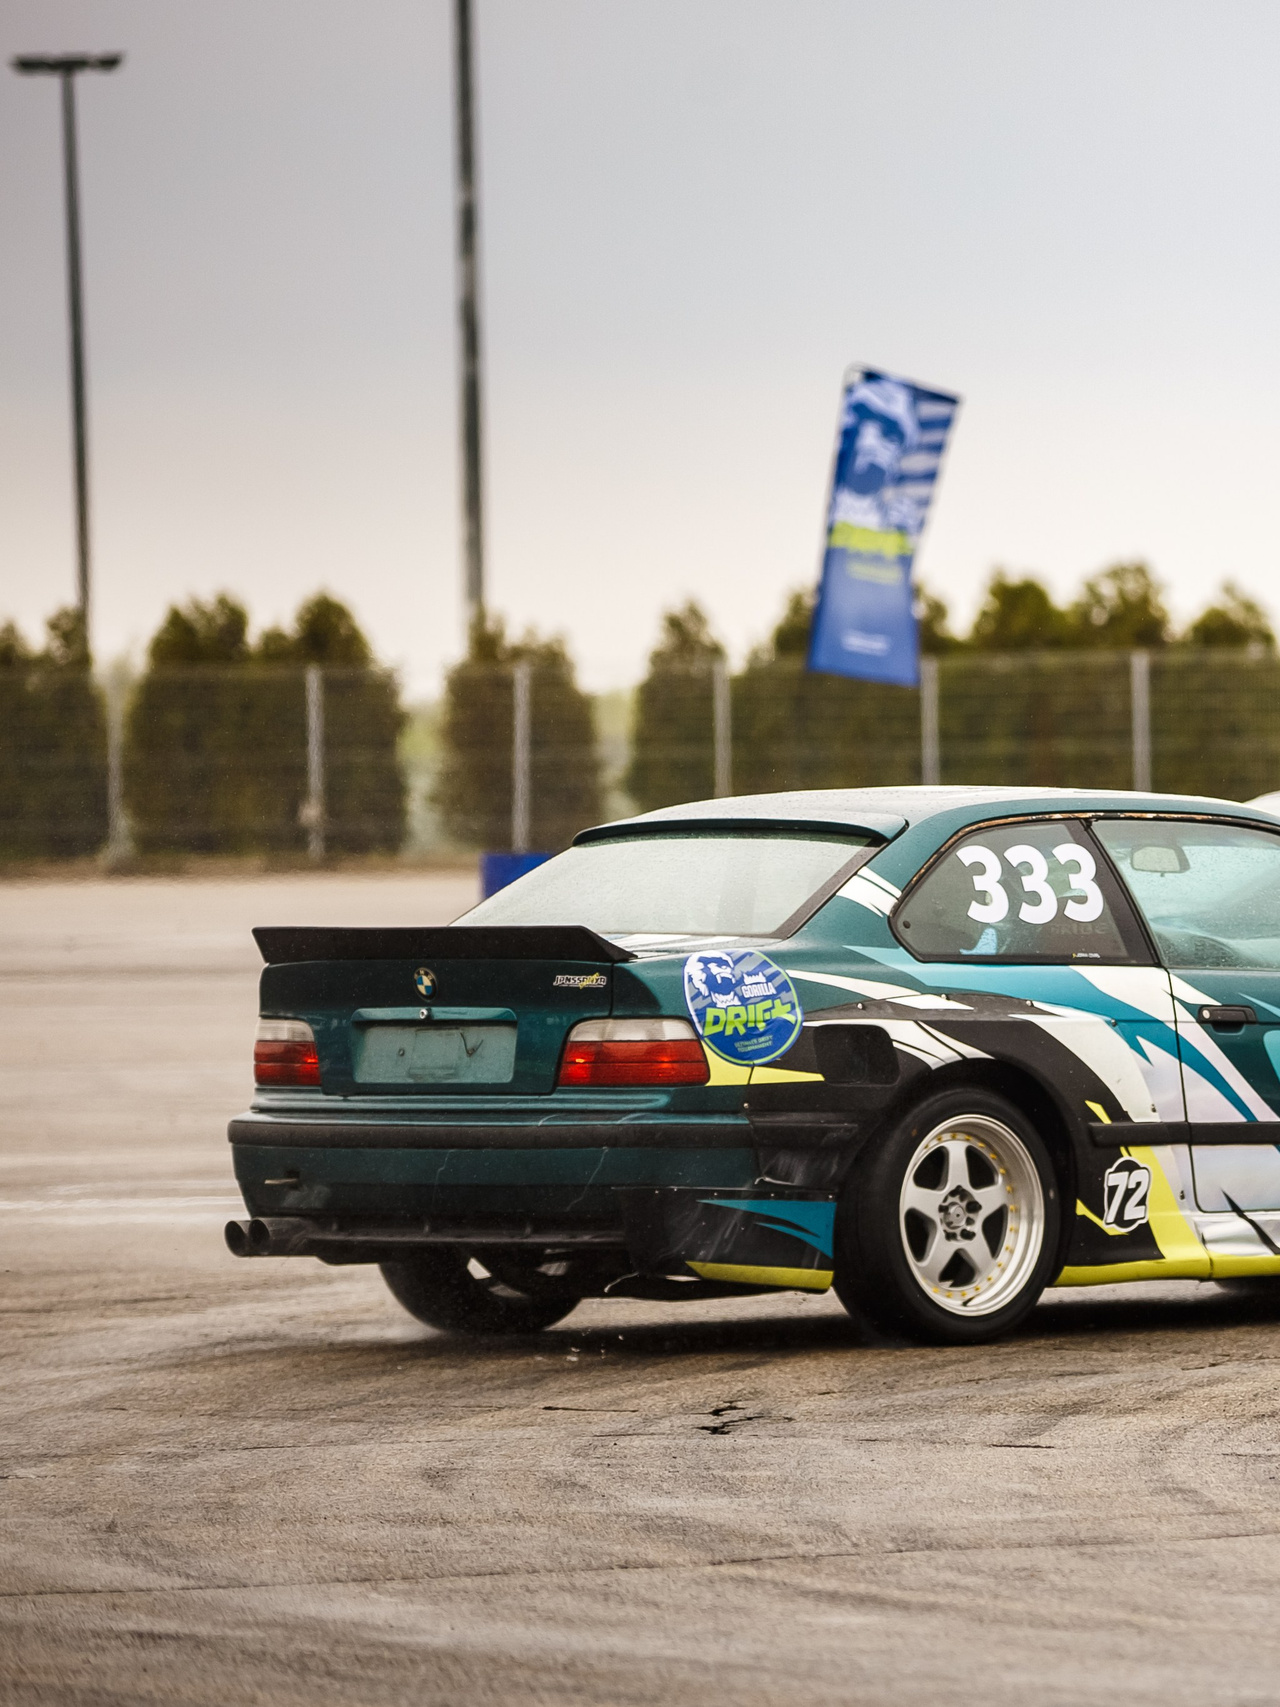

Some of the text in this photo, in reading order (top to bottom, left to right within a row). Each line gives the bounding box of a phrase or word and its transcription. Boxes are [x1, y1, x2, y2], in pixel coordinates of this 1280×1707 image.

[955, 843, 1104, 924] 333
[741, 982, 777, 998] GORILLA
[703, 998, 797, 1037] DRIFT
[1106, 1168, 1149, 1224] 72
